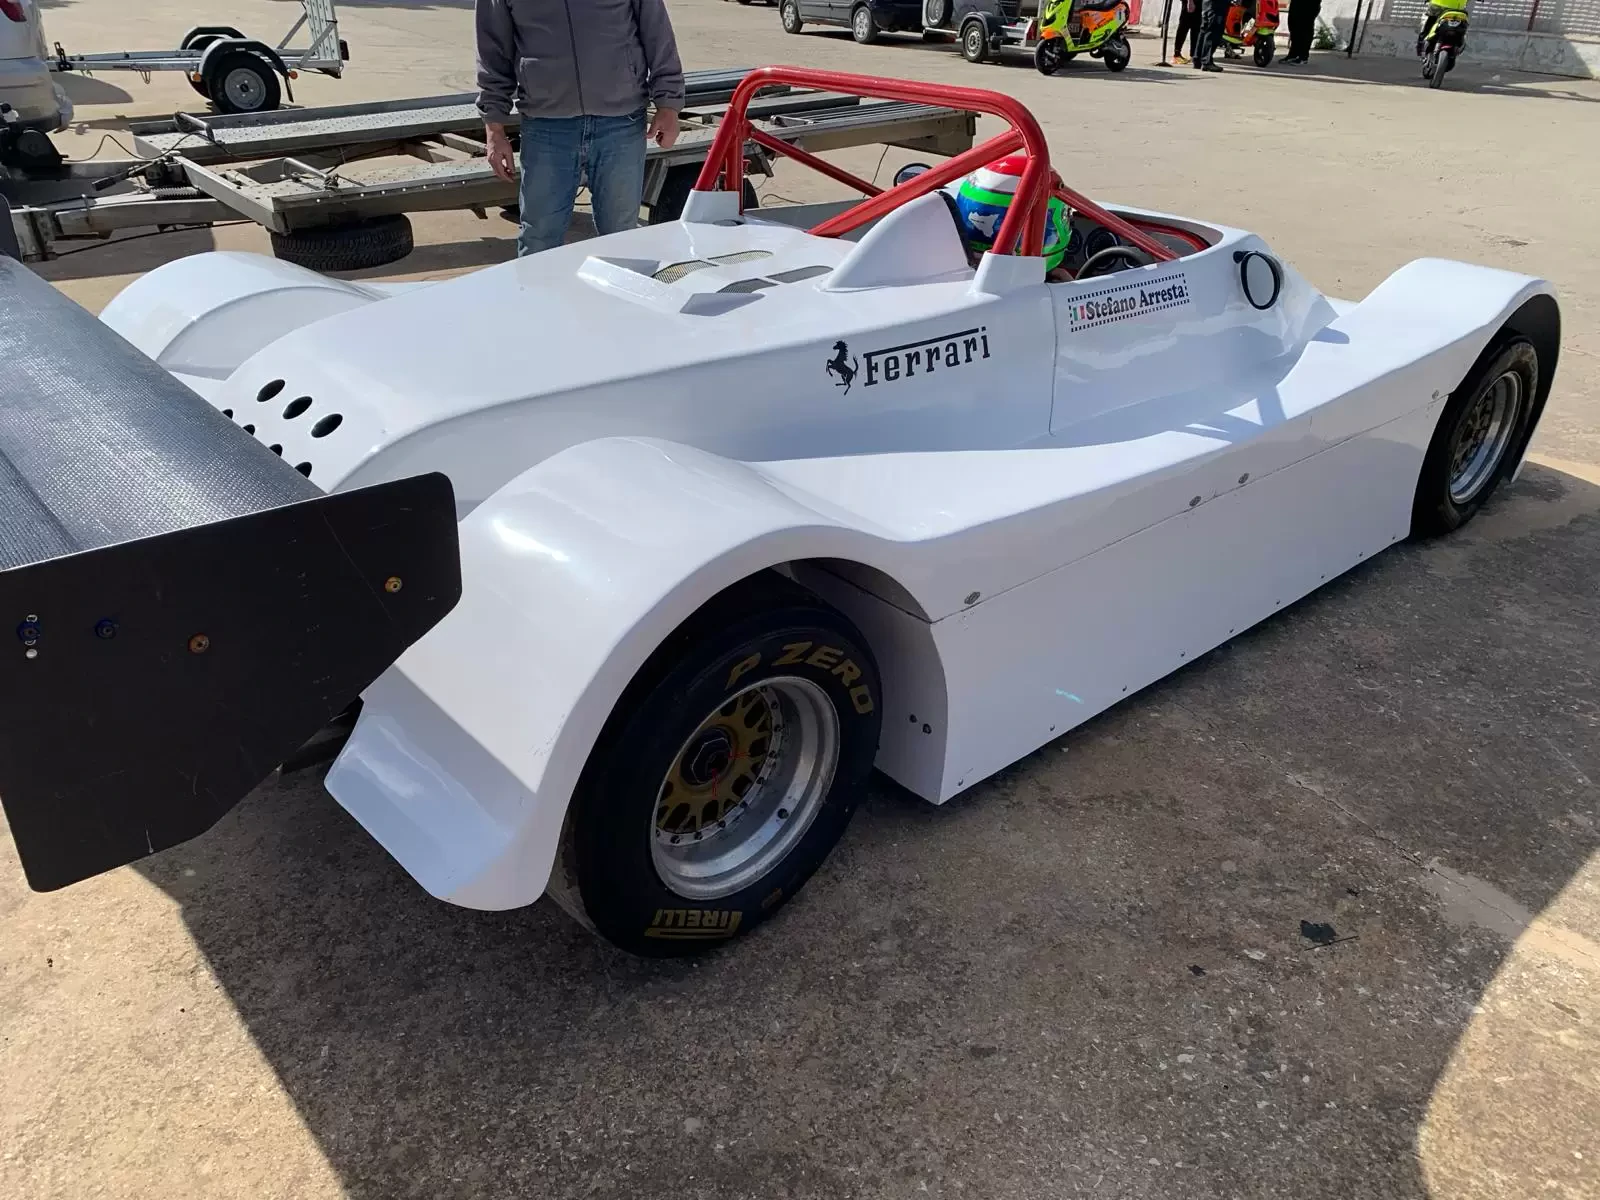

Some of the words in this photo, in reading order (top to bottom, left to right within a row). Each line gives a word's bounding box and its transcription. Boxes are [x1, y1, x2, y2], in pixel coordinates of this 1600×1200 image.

[1085, 296, 1137, 320] Stefano
[1138, 283, 1185, 308] Arresta
[862, 326, 991, 388] Ferrari
[724, 651, 762, 691] P
[771, 640, 875, 715] ZERO
[644, 908, 743, 939] PIRELLI
